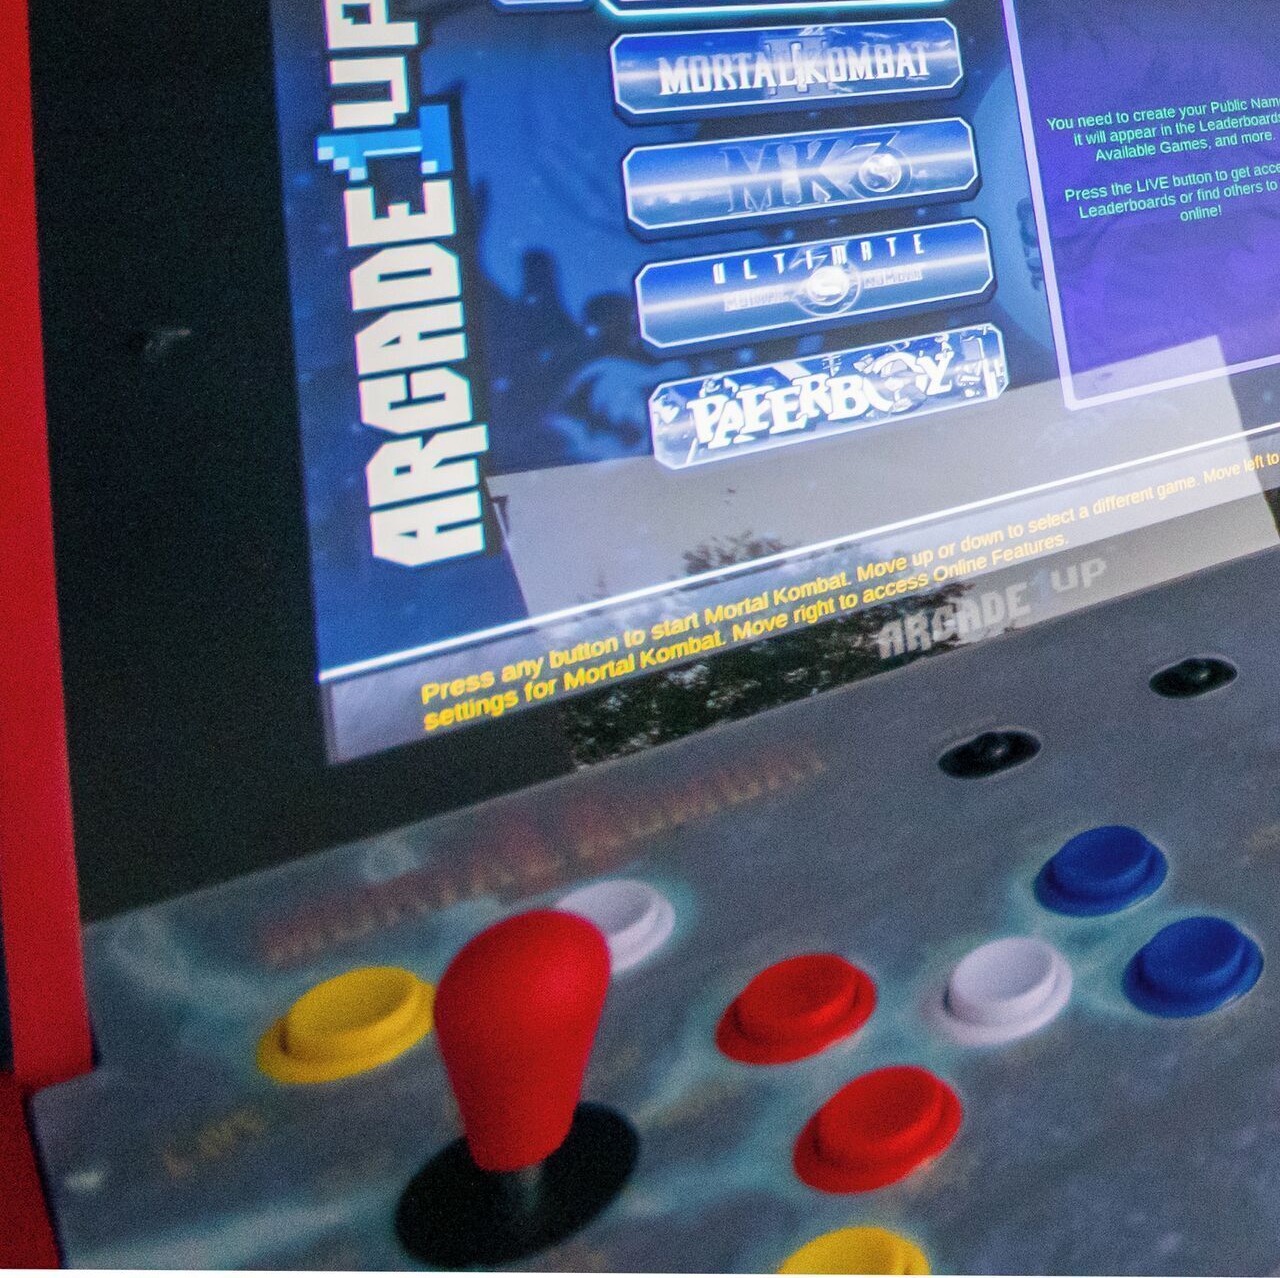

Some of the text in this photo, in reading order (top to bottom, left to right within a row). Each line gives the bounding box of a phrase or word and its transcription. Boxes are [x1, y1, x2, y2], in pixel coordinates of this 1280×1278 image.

[659, 41, 931, 96] MORTAL KOMBAT
[1047, 117, 1073, 131] You
[1078, 112, 1112, 127] need
[1116, 111, 1129, 124] to
[1133, 106, 1175, 122] create
[1179, 105, 1207, 120] your
[1210, 99, 1247, 115] Public
[1073, 133, 1082, 146] it
[1085, 131, 1106, 145] will
[1109, 127, 1157, 145] appear
[1161, 123, 1172, 137] in
[1175, 121, 1195, 134] the
[1095, 130, 1276, 162] Available Games, and more.
[1064, 186, 1108, 202] Press
[1111, 182, 1132, 196] the
[1136, 176, 1170, 194] LIVE
[1172, 171, 1212, 188] button
[1215, 168, 1228, 181] to
[1231, 165, 1250, 181] get
[1078, 194, 1177, 220] Leaderboards
[1180, 192, 1193, 204] or
[1197, 187, 1220, 202] find
[1223, 182, 1263, 199] others
[1266, 179, 1278, 192] to
[1179, 204, 1222, 222] online!
[712, 233, 925, 284] ULTIMATE
[687, 349, 954, 449] PAPERBOY
[421, 669, 495, 705] Press
[501, 655, 544, 684] any
[549, 634, 618, 671] button
[623, 627, 646, 649] to
[650, 612, 700, 642] start
[704, 593, 769, 628] Mortal
[772, 572, 852, 606] Kombat.
[857, 554, 908, 582] Move
[912, 547, 934, 569] up
[937, 542, 957, 560] or
[960, 527, 1005, 554] down
[1007, 521, 1025, 540] to
[1028, 508, 1075, 534] select
[1078, 505, 1090, 519] a
[1092, 484, 1154, 516] different
[1156, 474, 1201, 501] game.
[1204, 464, 1240, 485] Move
[1243, 453, 1265, 473] left
[1266, 450, 1280, 467] to
[423, 532, 1070, 732] settings for Mortal Kombat. Move right to access Online Features.
